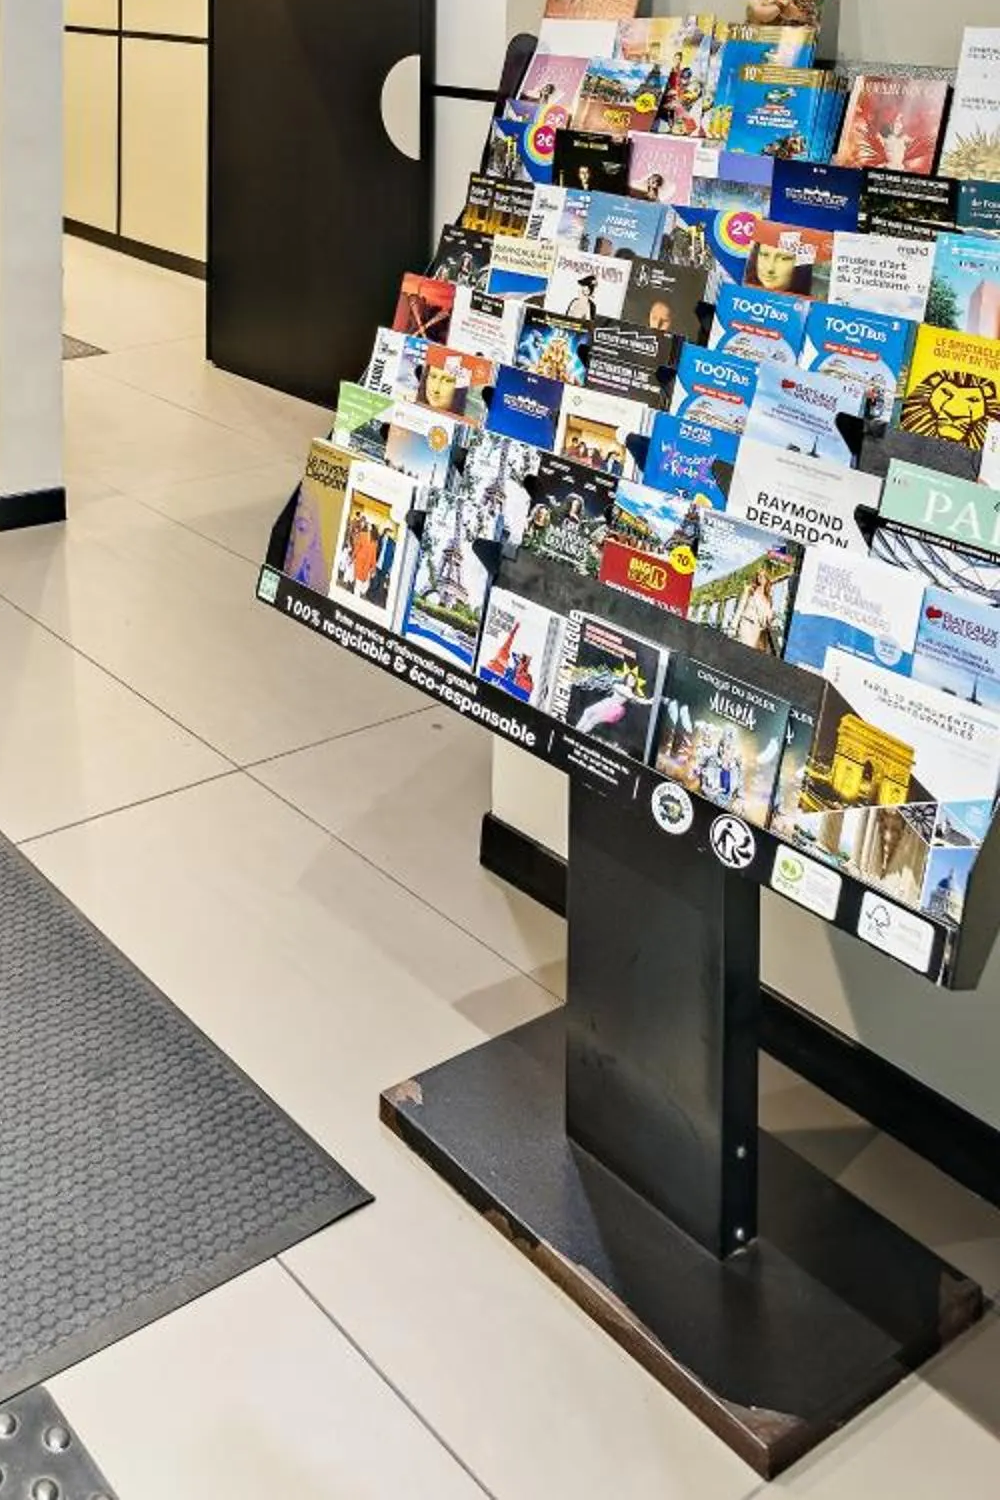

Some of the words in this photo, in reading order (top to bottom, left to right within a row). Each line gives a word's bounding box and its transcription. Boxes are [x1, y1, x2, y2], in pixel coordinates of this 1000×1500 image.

[731, 220, 755, 237] 2€
[746, 506, 849, 549] DEPARDON
[757, 490, 843, 531] RAYMOND
[285, 595, 322, 627] 100%
[323, 619, 391, 665] recyclable
[393, 656, 406, 672] &
[409, 666, 537, 747] éco-responsable
